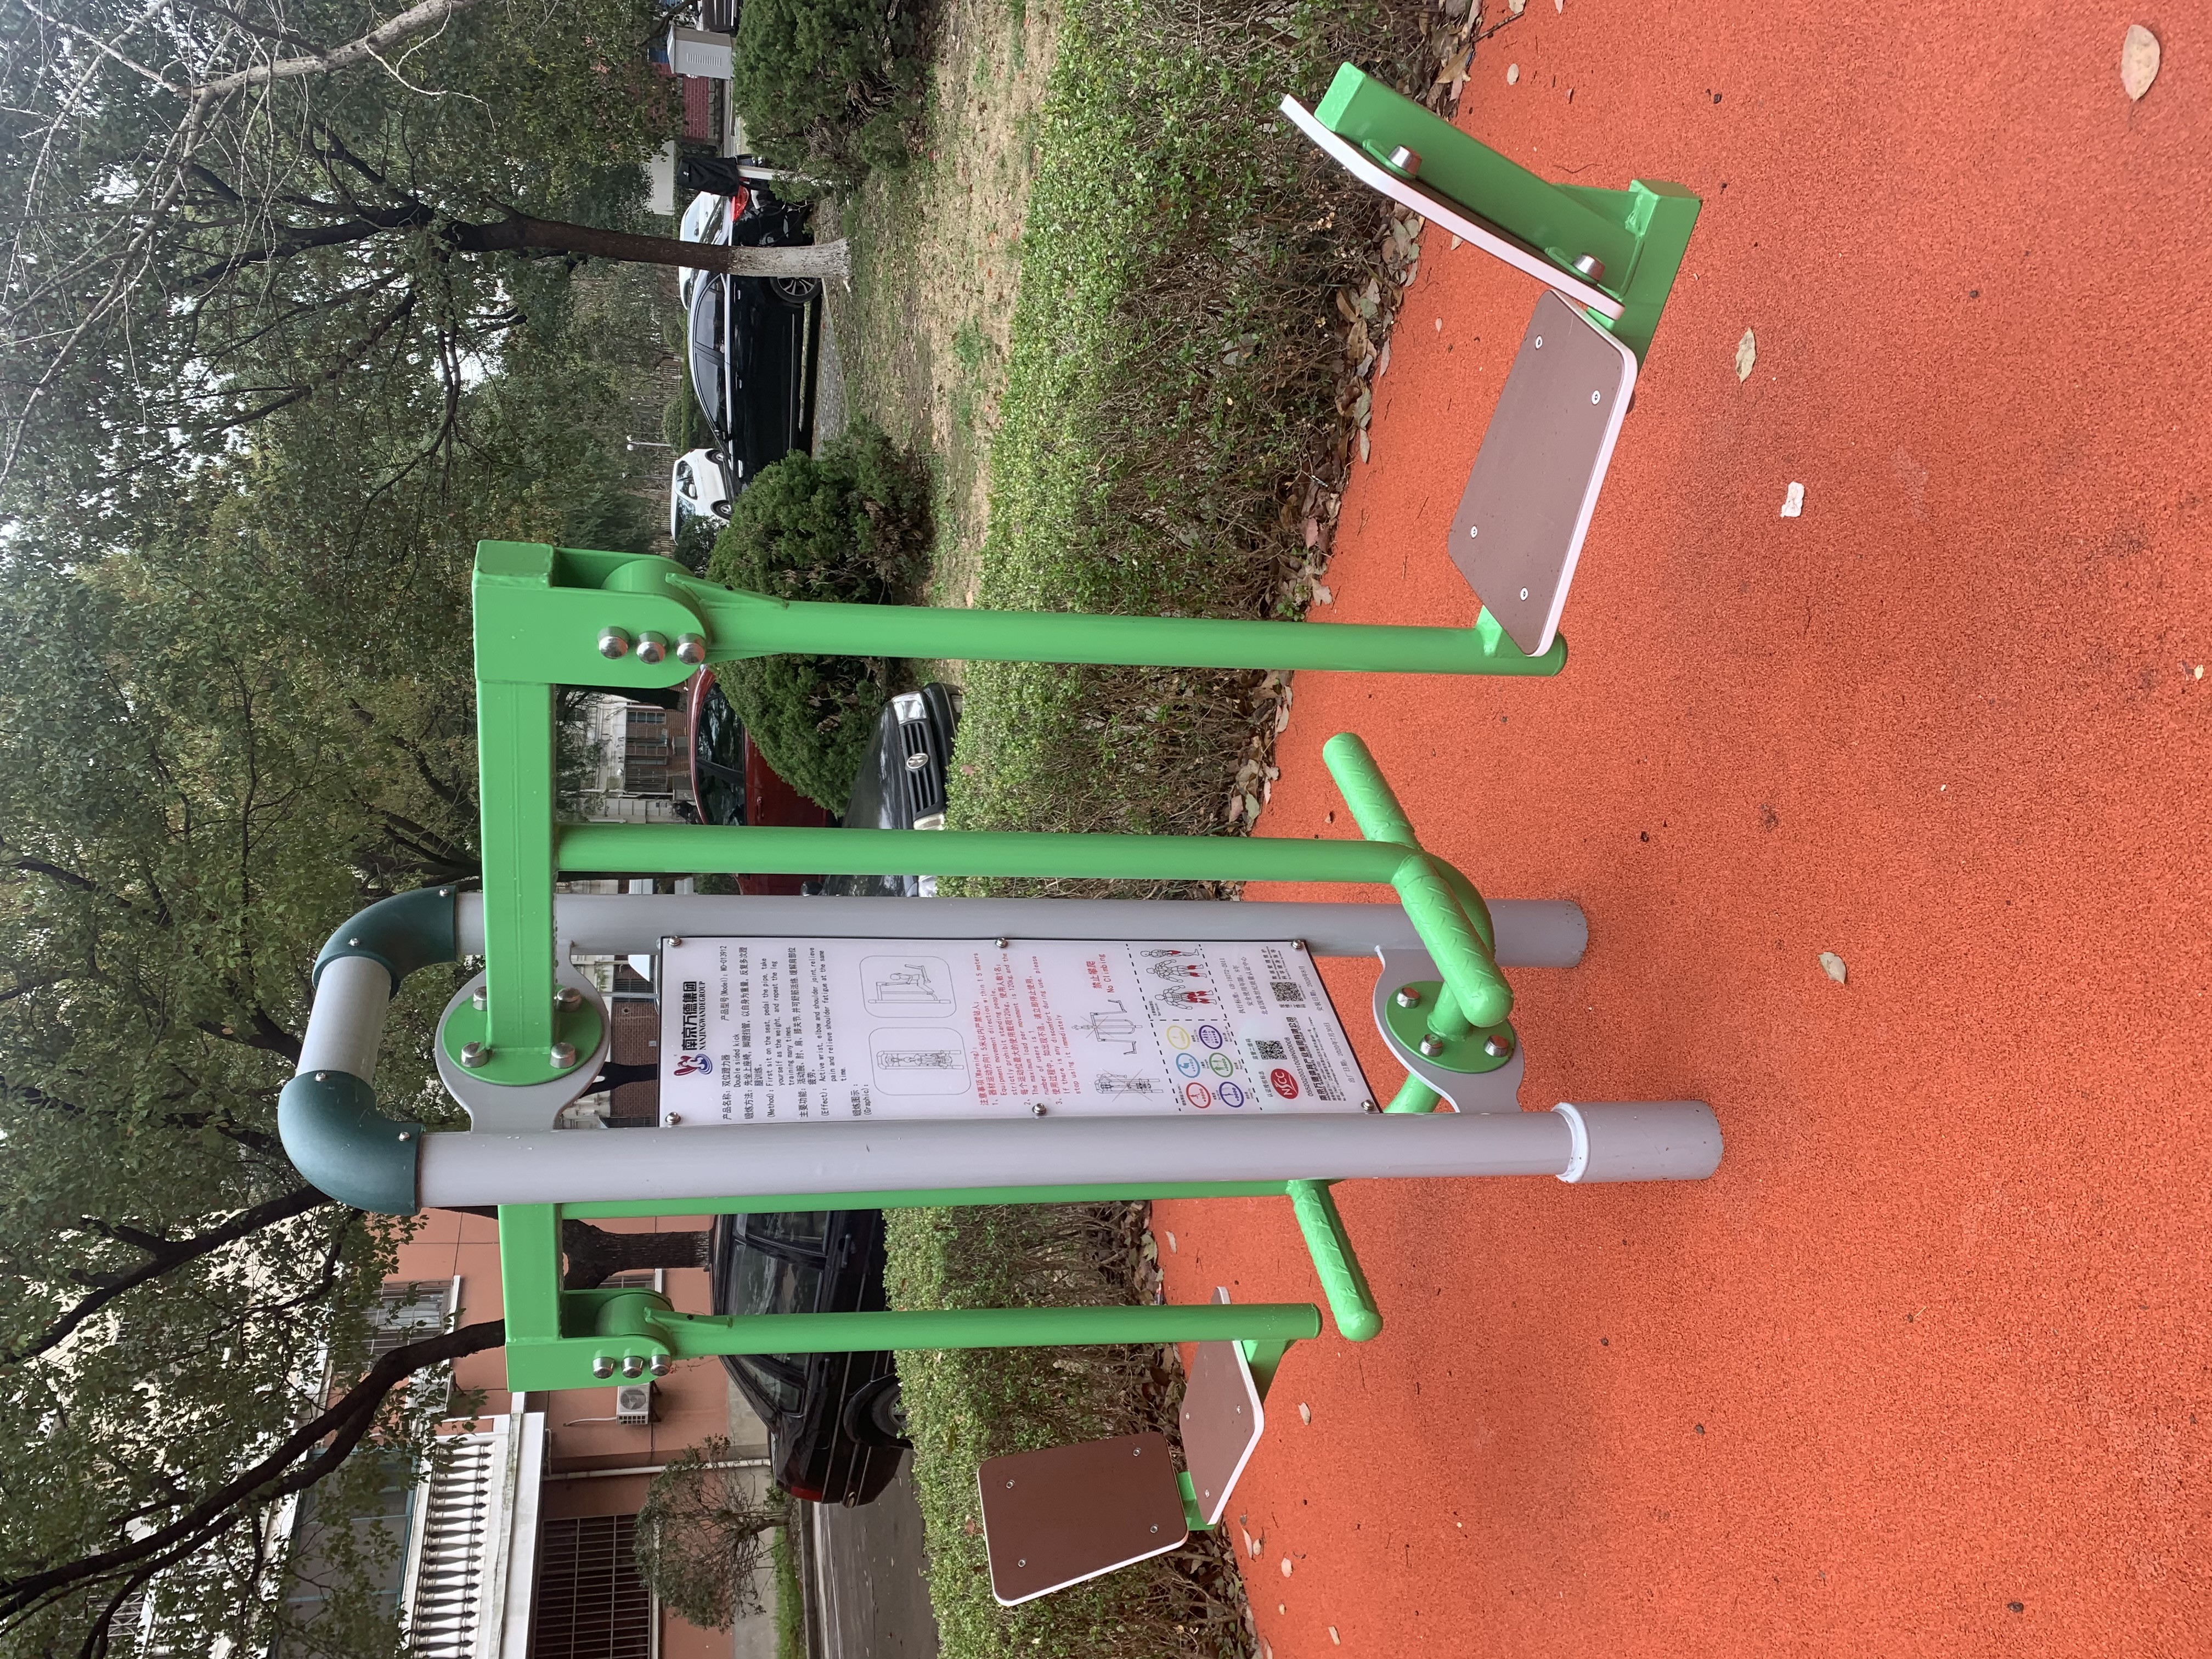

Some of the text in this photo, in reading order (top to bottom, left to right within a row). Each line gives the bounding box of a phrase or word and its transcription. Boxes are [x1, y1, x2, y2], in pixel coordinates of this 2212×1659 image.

[1032, 956, 1041, 973] please
[1086, 961, 1102, 989] 禁止攀爬
[1098, 954, 1111, 982] Climbing
[762, 1002, 770, 1015] pedal
[1040, 991, 1048, 1009] during
[682, 981, 697, 1051] 南京万德集团
[823, 1007, 831, 1029] shoulder
[984, 1006, 994, 1034] direction
[995, 1012, 1005, 1037] standing
[1013, 1003, 1023, 1028] movement
[1045, 1012, 1057, 1043] discomfort
[1055, 1015, 1069, 1048] immediately
[990, 1037, 1000, 1063] movement
[1001, 1040, 1012, 1066] prohibit
[1020, 1043, 1029, 1055] load
[775, 1061, 785, 1086] yourself
[829, 1069, 837, 1082] pain
[996, 1066, 1007, 1096] Equipment
[1007, 1069, 1017, 1095] strictly
[1026, 1059, 1035, 1082] maximum
[1059, 1068, 1068, 1085] there
[1068, 1062, 1076, 1077] using
[1040, 1076, 1049, 1095] number
[1273, 1072, 1293, 1095] NSCC
